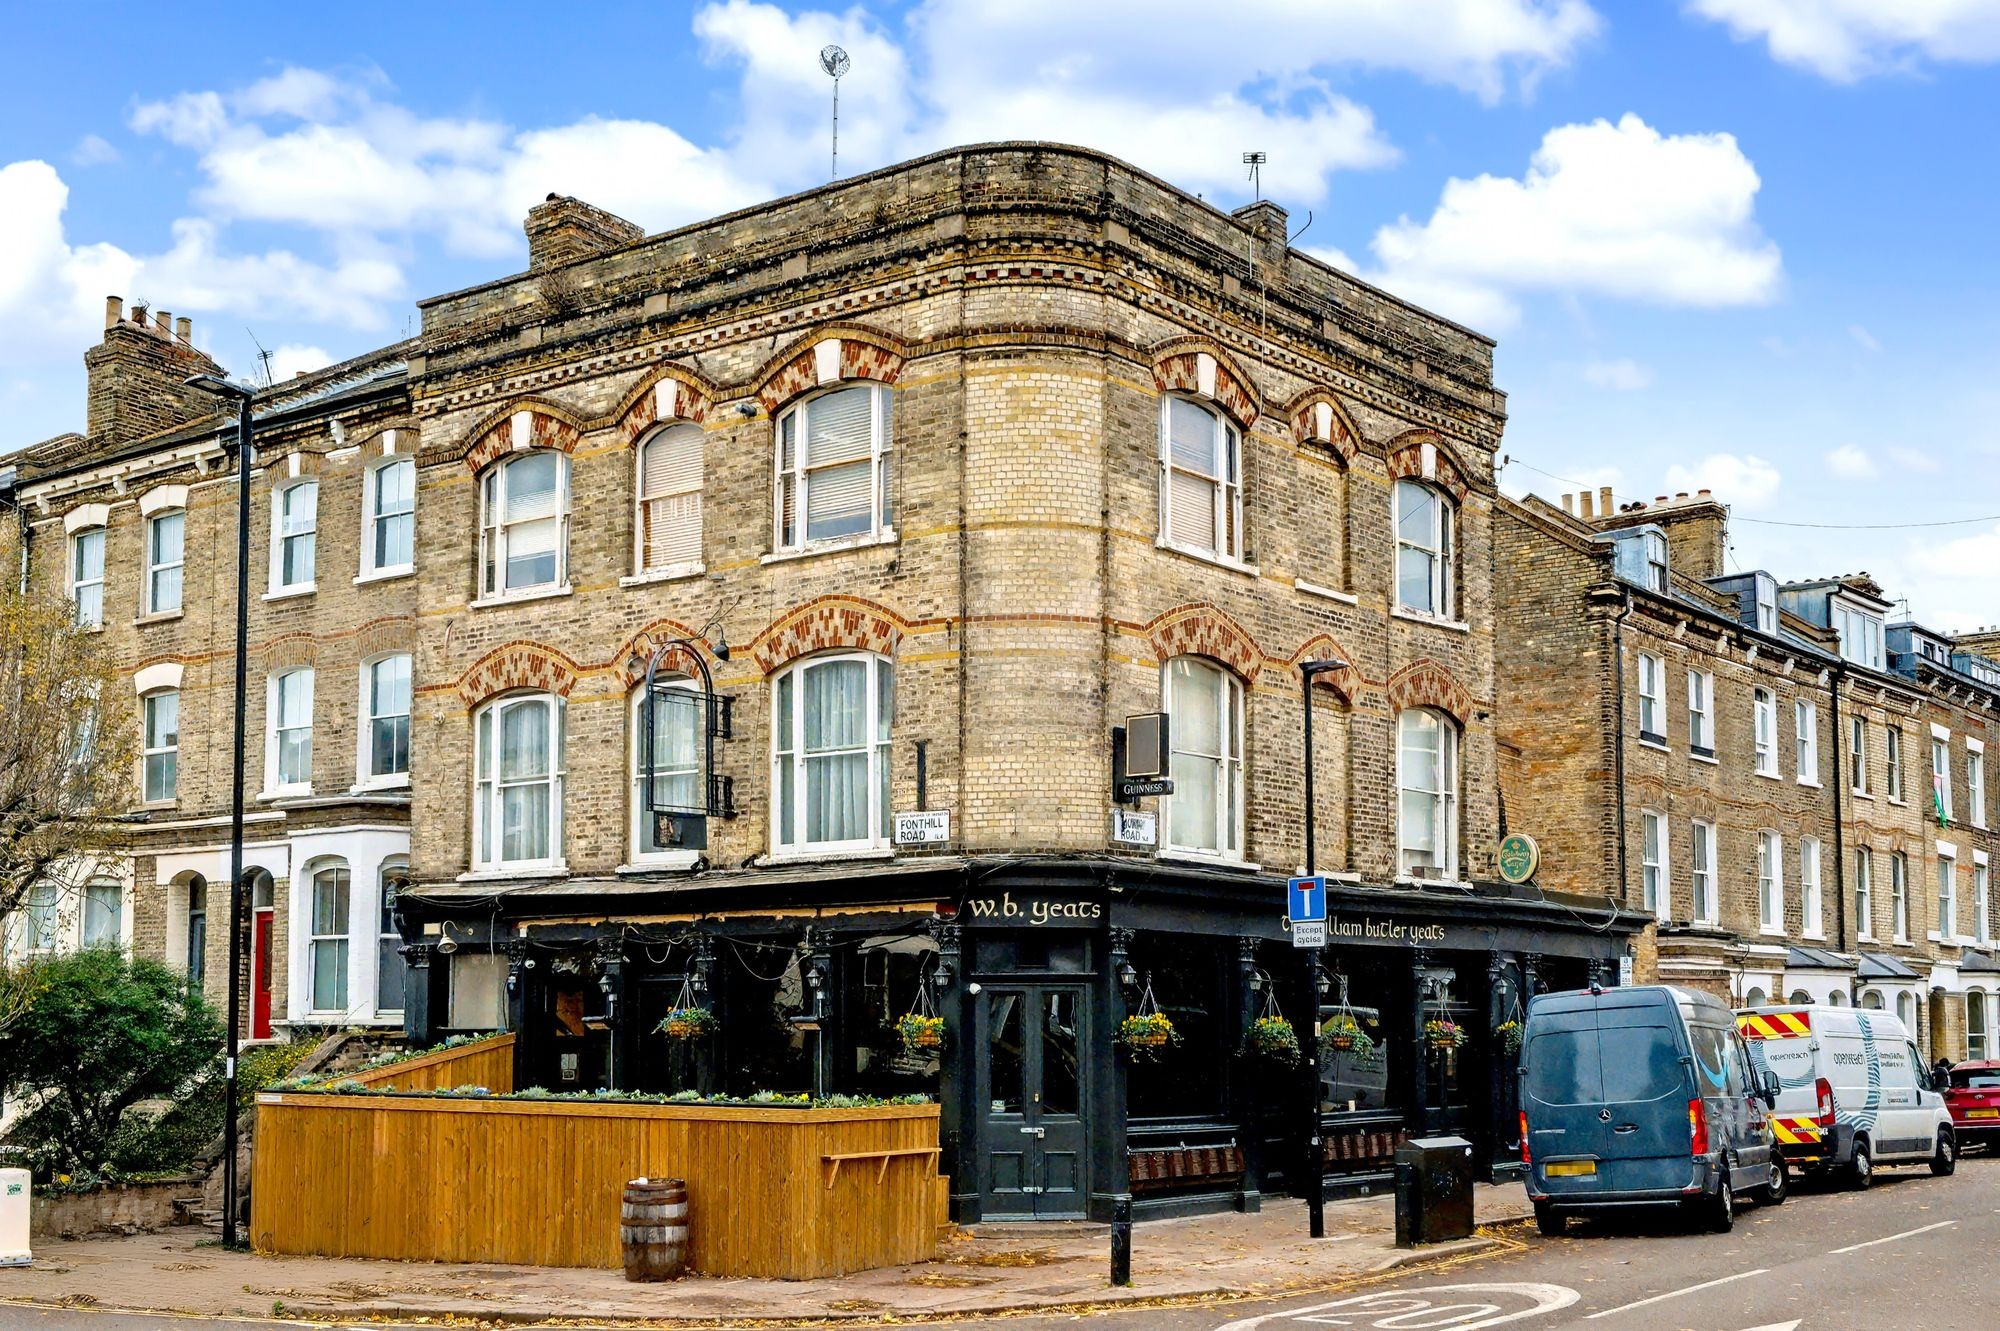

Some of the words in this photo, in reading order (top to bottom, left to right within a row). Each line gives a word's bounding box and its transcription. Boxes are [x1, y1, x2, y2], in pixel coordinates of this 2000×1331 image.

[1123, 783, 1163, 795] GUINNESS
[900, 817, 943, 830] FONTHILL
[900, 830, 926, 841] ROAD
[1120, 830, 1141, 841] ROAD
[968, 892, 1024, 917] w.b.
[1029, 900, 1101, 925] yeats
[1296, 926, 1323, 934] Except
[1328, 915, 1362, 936] lliam
[1365, 917, 1407, 939] butler
[1409, 924, 1445, 945] yeats
[1297, 936, 1321, 944] cycles
[1769, 1052, 1809, 1062] openreach
[1833, 1052, 1866, 1066] openreach
[1291, 1298, 1501, 1329] 20
